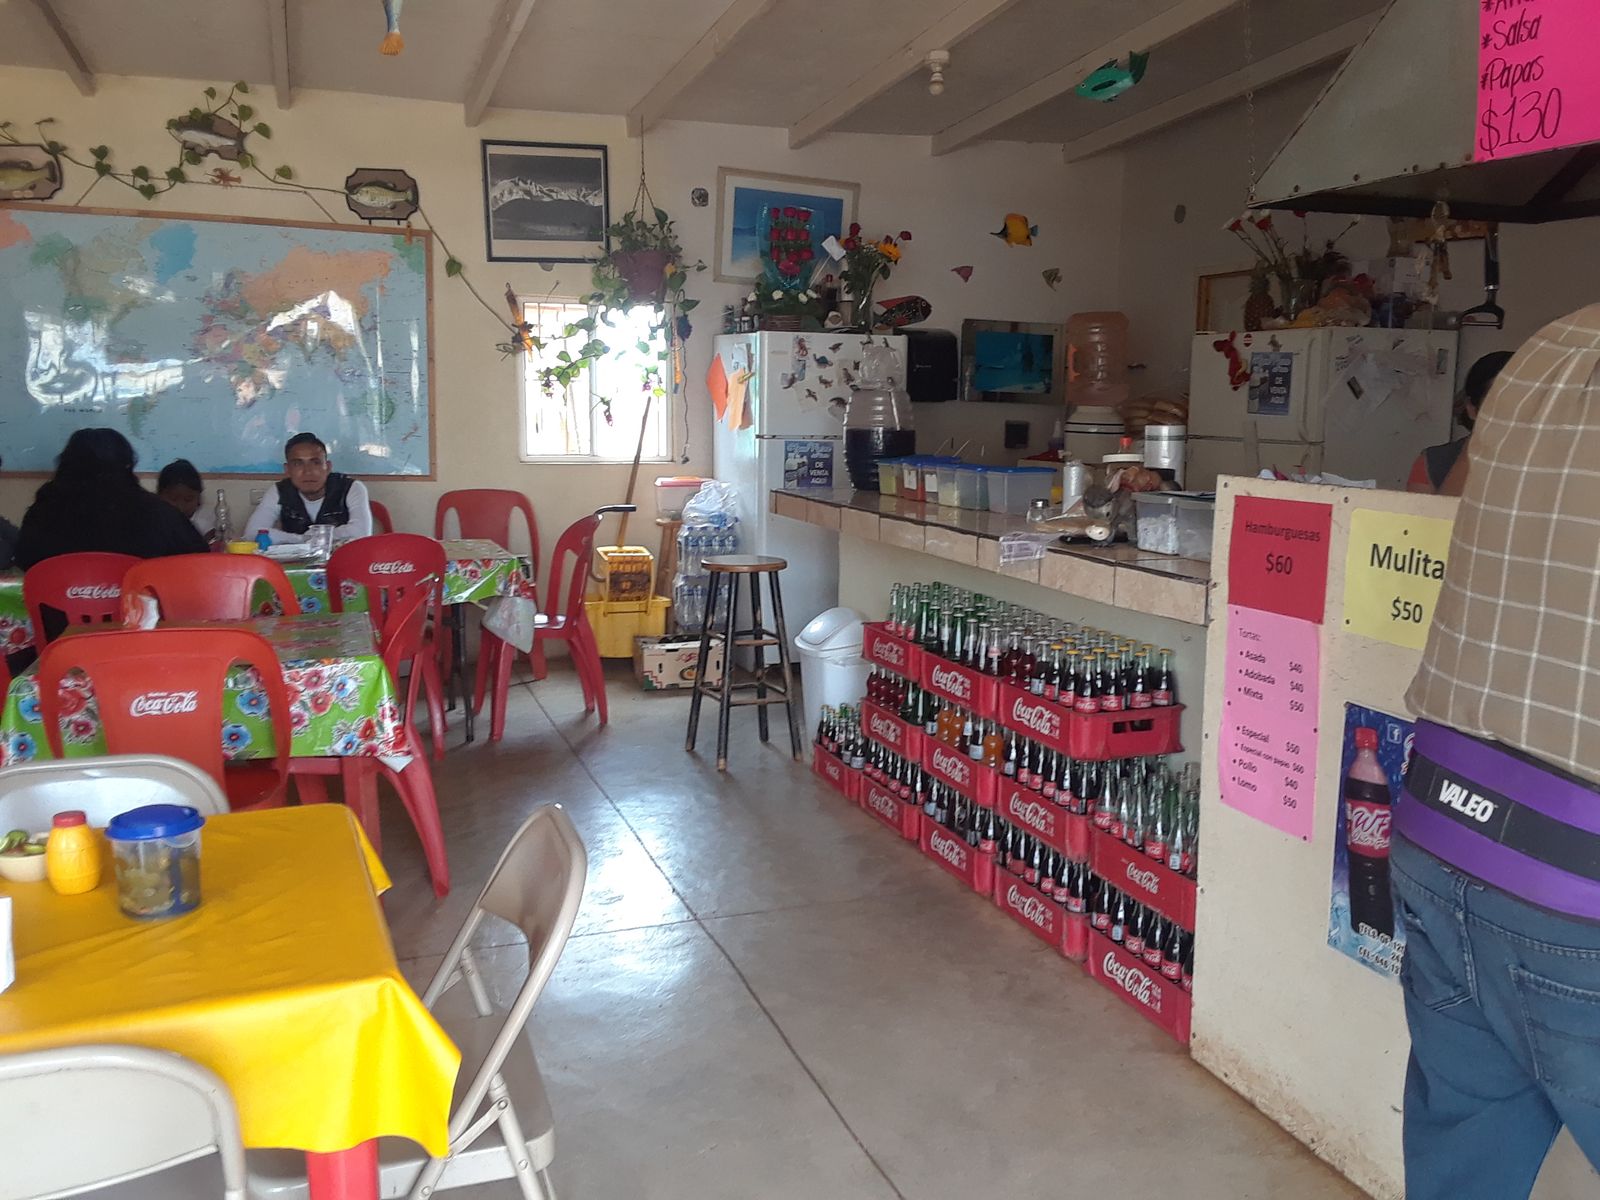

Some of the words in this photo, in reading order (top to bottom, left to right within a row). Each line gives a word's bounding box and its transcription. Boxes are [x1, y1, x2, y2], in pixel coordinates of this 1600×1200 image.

[1493, 8, 1542, 50] Salsa
[1485, 56, 1544, 97] Papas
[1480, 88, 1562, 157] $130
[1245, 521, 1321, 541] Hamburguesas
[1265, 553, 1293, 575] $60
[1391, 596, 1423, 624] $50
[1239, 758, 1257, 773] Pollo
[1439, 779, 1494, 823] VALEO
